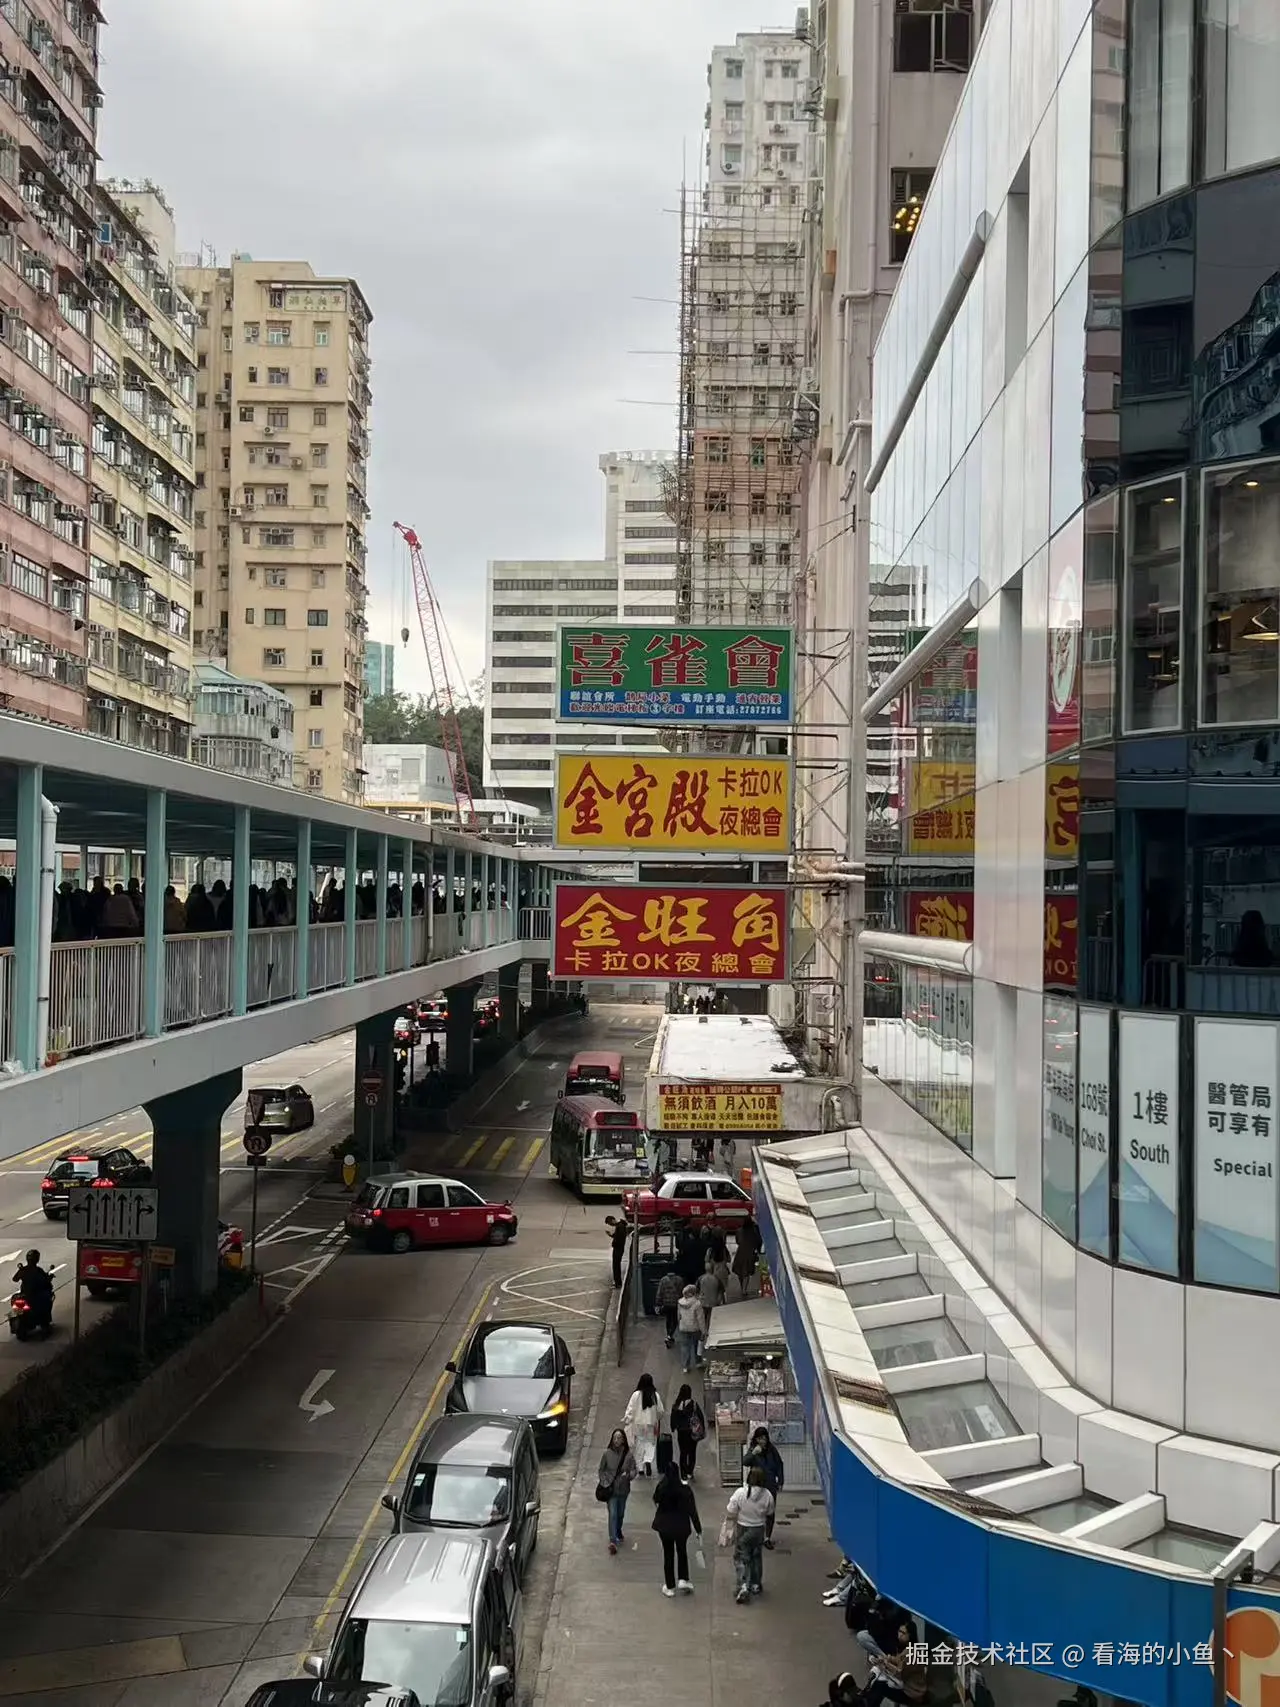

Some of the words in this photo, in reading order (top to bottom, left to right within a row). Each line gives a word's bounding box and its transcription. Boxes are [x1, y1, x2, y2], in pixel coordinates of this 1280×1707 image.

[566, 632, 785, 688] 喜雀會
[564, 761, 718, 838] 金宮殿
[717, 766, 783, 798] 卡拉OK
[719, 806, 783, 837] 夜總會
[560, 892, 780, 951] 金旺角
[565, 949, 776, 974] 卡拉OK夜總會
[664, 1096, 717, 1111] 無須飲酒
[725, 1096, 777, 1111] 月入10萬
[1132, 1089, 1169, 1126] 1樓
[1208, 1082, 1271, 1109] 醫管局
[1208, 1110, 1271, 1138] 可享有
[1130, 1139, 1170, 1165] South
[1213, 1158, 1273, 1178] Special
